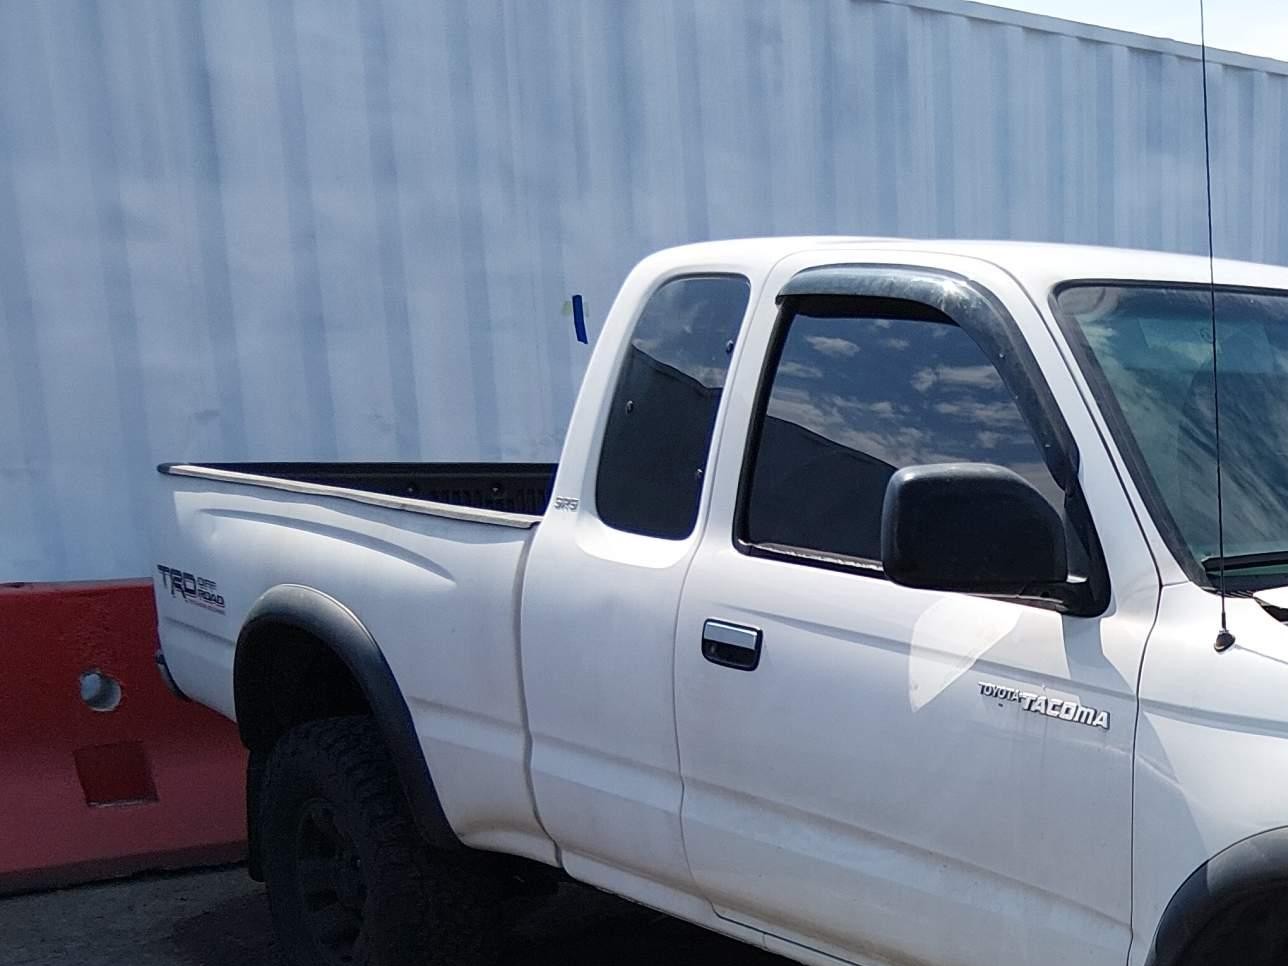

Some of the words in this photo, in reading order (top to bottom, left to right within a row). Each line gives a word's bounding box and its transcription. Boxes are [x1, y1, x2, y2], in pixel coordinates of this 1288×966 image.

[553, 496, 579, 511] SR5
[157, 564, 196, 602] TRD
[197, 588, 225, 608] ROAD
[977, 681, 1021, 703] TOYOTA
[1019, 691, 1110, 730] TACOMA
